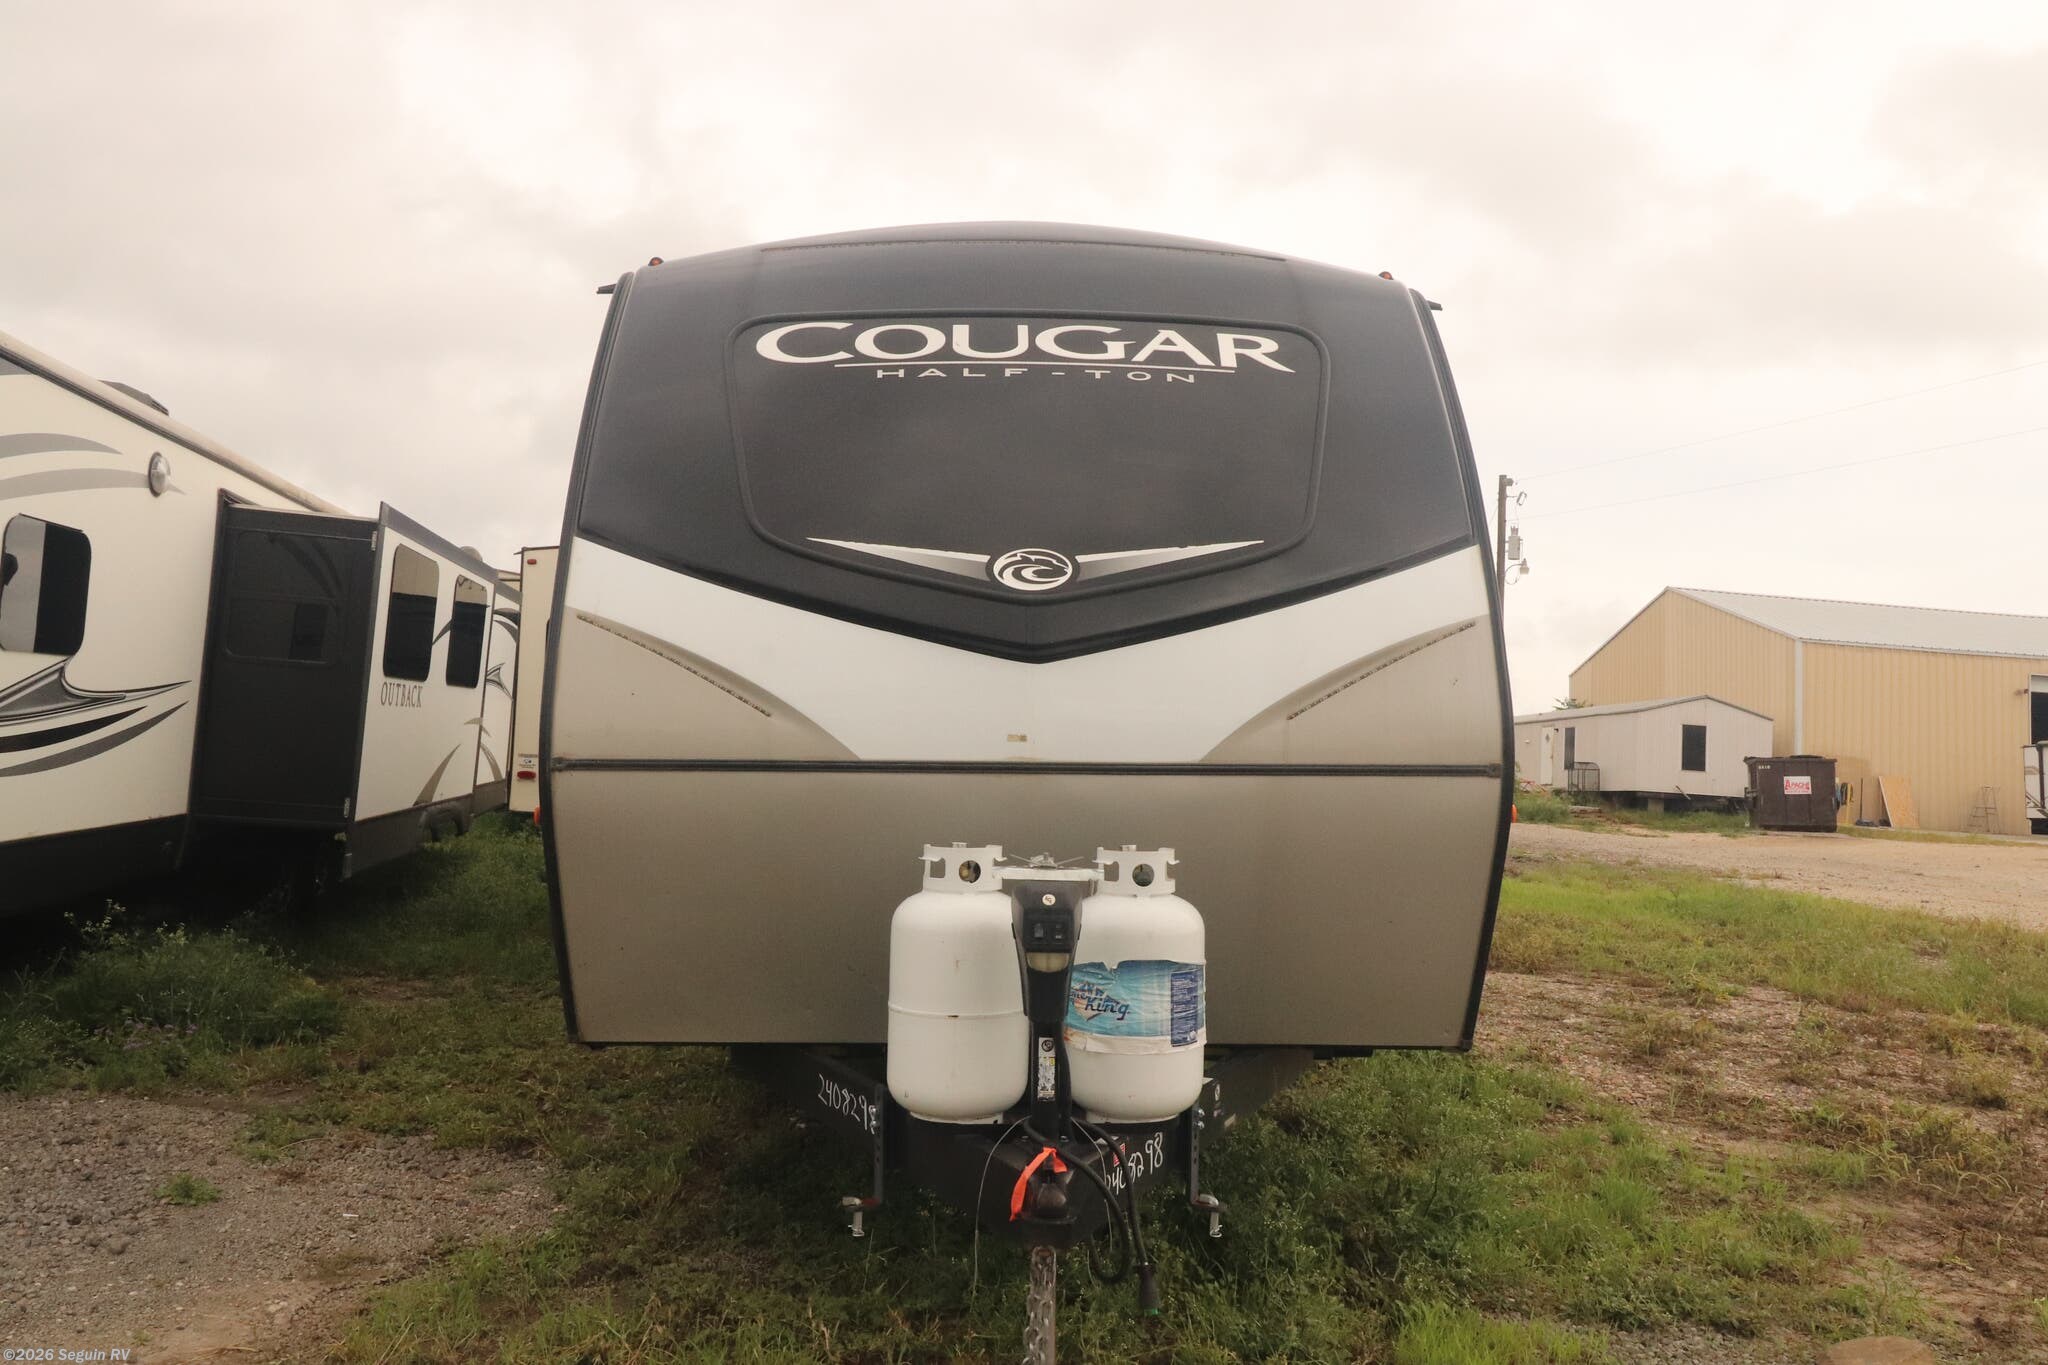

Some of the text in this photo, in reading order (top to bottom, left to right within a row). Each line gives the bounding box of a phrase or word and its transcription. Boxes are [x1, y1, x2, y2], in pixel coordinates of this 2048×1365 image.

[756, 322, 1296, 373] COUGAR
[381, 682, 423, 708] OUTBACK
[1084, 997, 1130, 1021] King
